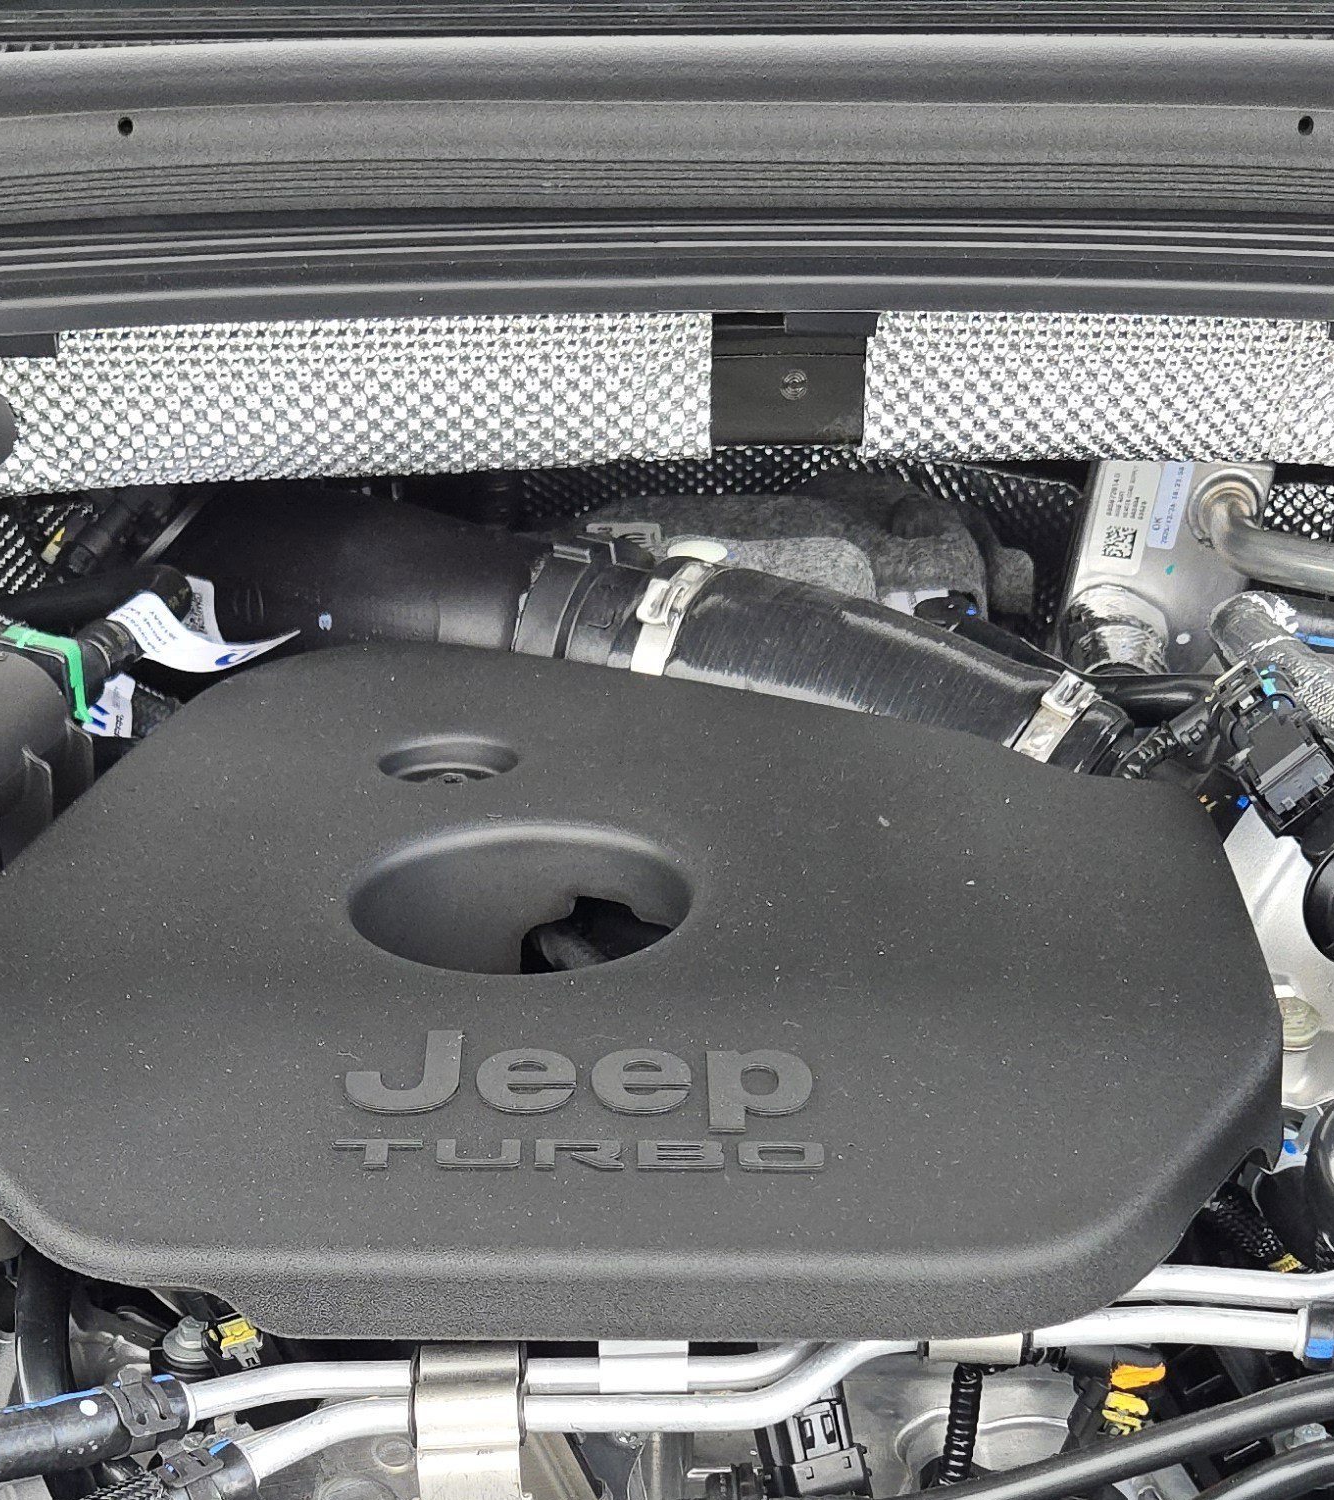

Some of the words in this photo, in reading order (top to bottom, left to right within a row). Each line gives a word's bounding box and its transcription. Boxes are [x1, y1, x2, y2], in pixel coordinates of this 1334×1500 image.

[1152, 516, 1163, 531] OK
[343, 1030, 814, 1134] Jeep
[331, 1137, 827, 1173] TURBO
